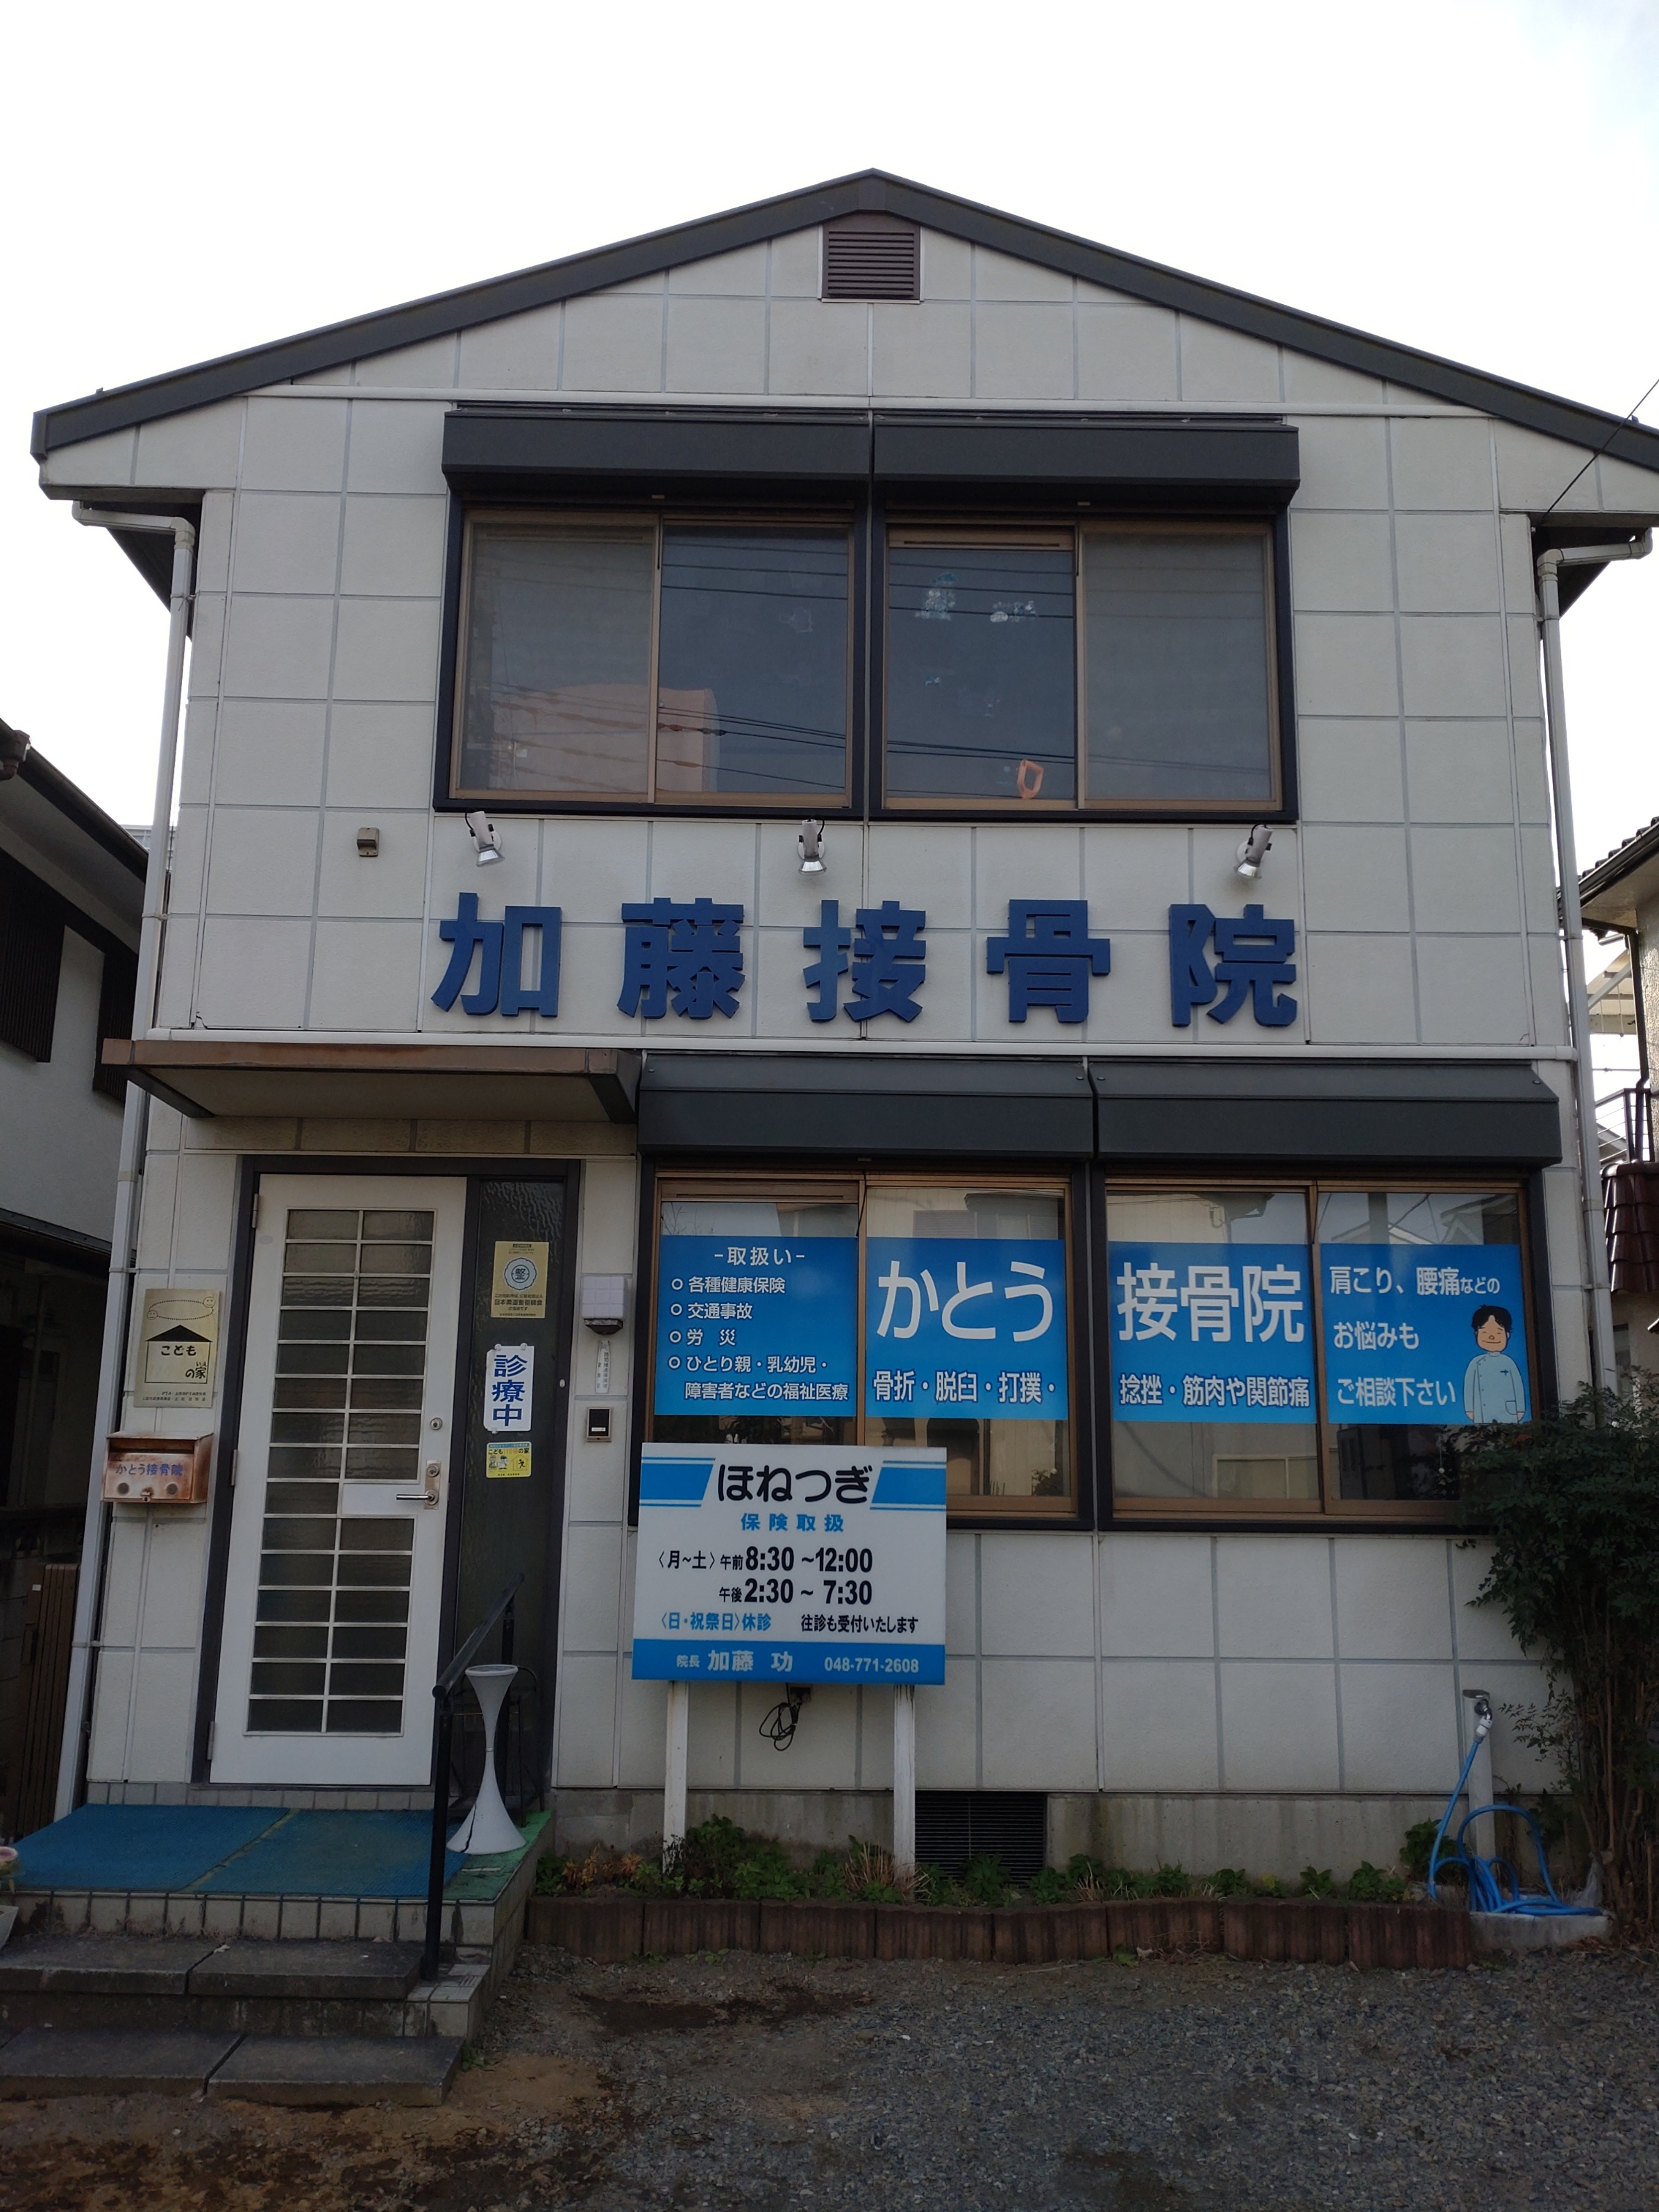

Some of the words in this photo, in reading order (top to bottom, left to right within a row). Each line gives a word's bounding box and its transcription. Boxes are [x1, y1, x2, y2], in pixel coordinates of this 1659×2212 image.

[431, 892, 1297, 1028] 加藤接骨院
[687, 1276, 786, 1293] 各種健康保険
[1329, 1266, 1501, 1296] 肩こり、腰痛などの
[687, 1302, 753, 1320] 交通事故
[877, 1260, 1053, 1342] かとう
[1117, 1262, 1304, 1343] 接骨院
[1333, 1321, 1420, 1350] お悩みも
[161, 1345, 196, 1356] こども
[185, 1366, 206, 1379] の家
[491, 1354, 528, 1427] 診療中
[684, 1382, 849, 1400] 障害者などの福祉医療
[1119, 1374, 1311, 1408] 捻挫・筋肉や関節痛
[1336, 1377, 1456, 1407] ご相談下さい
[115, 1463, 183, 1476] かとう接骨院
[718, 1464, 873, 1504] ほねつぎ
[741, 1513, 844, 1532] 保険取扱
[801, 1614, 919, 1634] 往診も受付いたします
[824, 1657, 920, 1673] 048-771-2608
